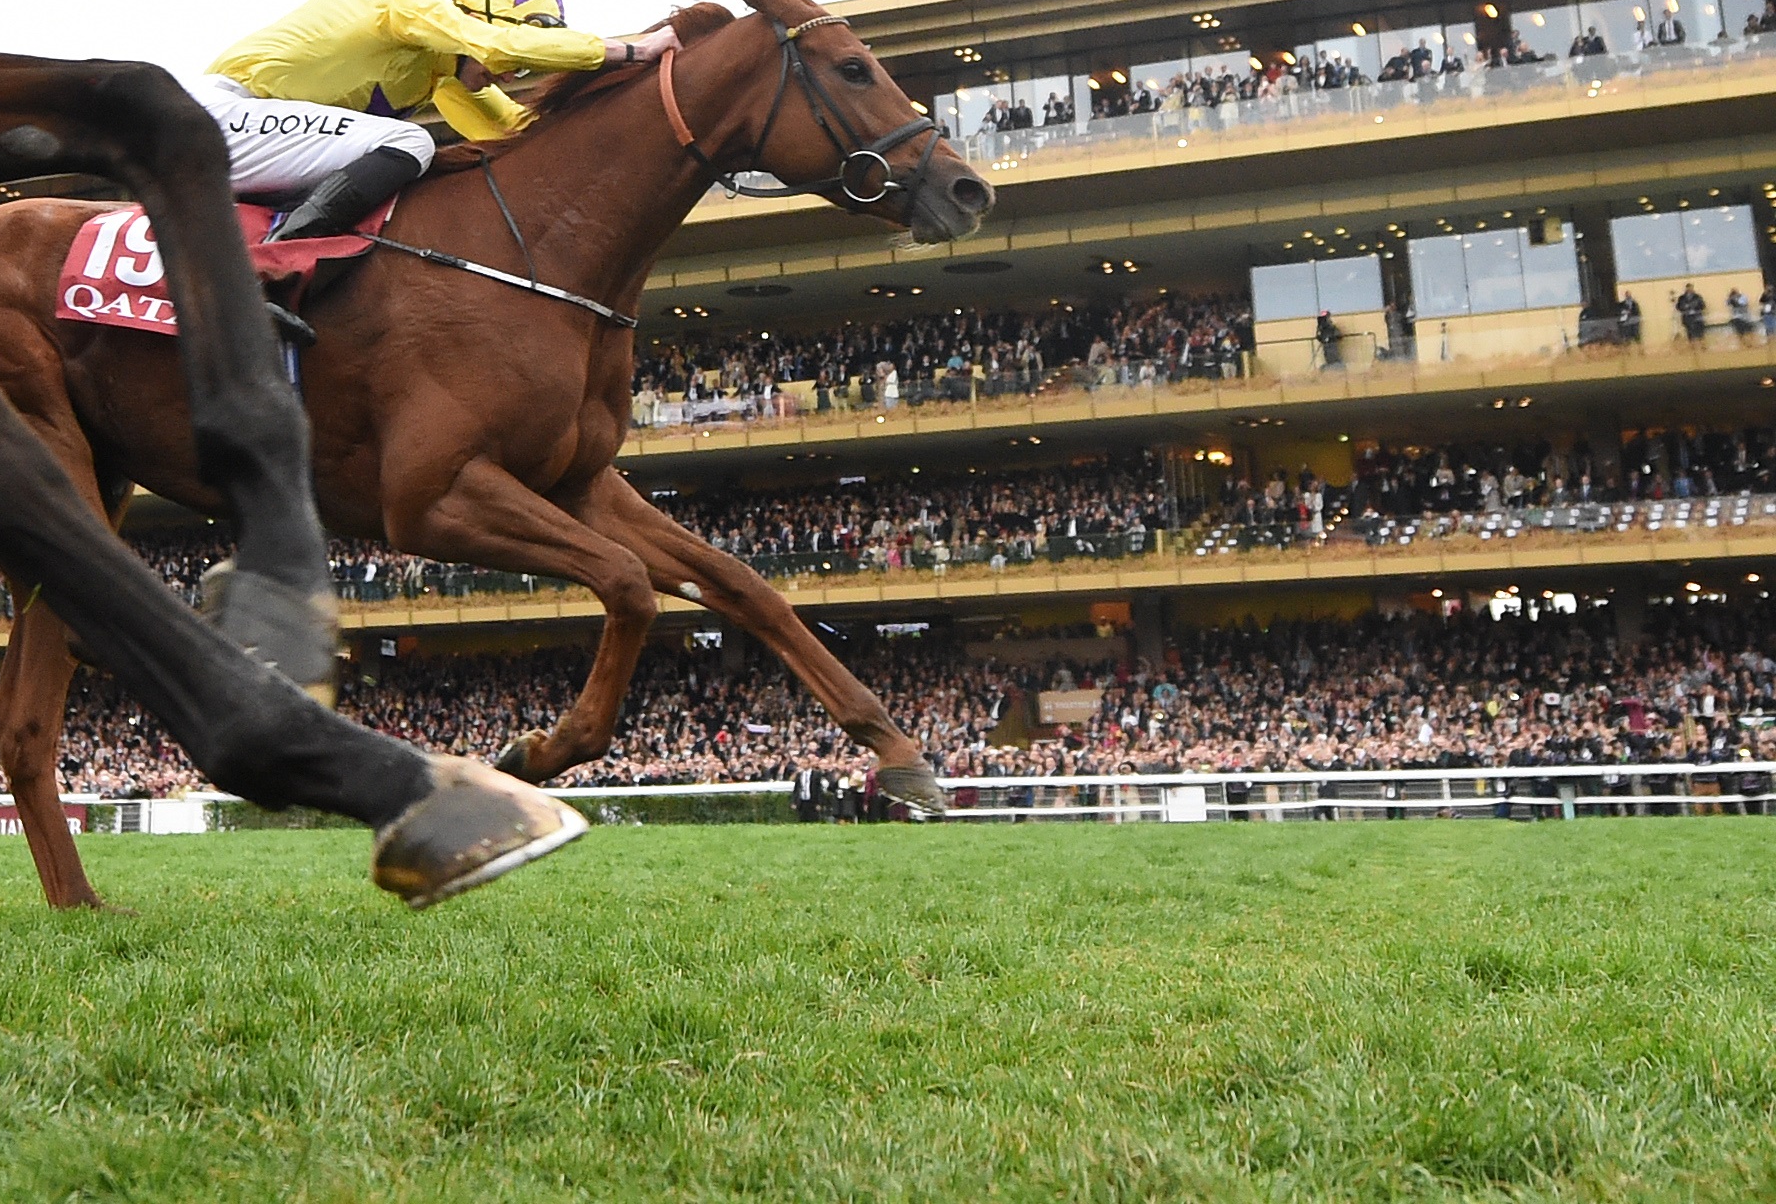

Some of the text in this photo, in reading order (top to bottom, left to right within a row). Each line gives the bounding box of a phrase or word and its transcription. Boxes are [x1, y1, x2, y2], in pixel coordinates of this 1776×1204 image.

[229, 112, 355, 136] J. DOYLE
[82, 211, 165, 287] 19
[64, 284, 177, 325] QAT
